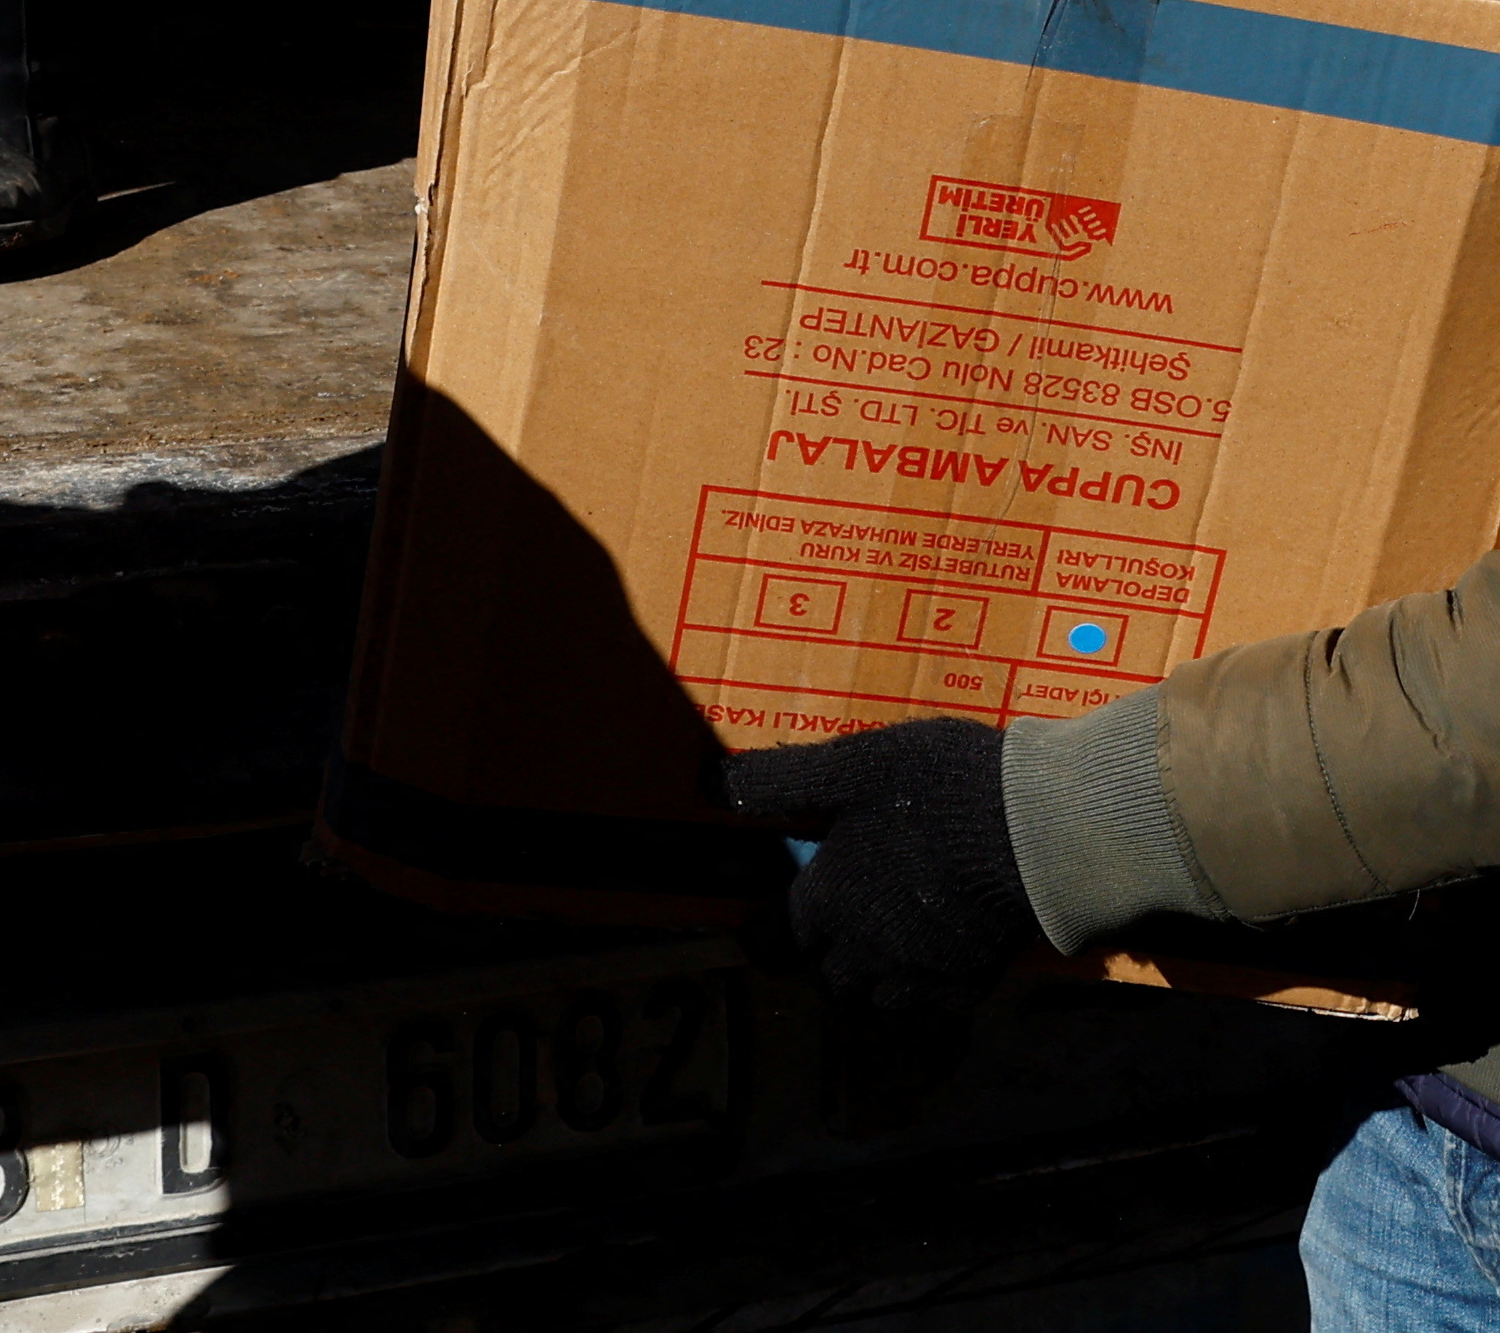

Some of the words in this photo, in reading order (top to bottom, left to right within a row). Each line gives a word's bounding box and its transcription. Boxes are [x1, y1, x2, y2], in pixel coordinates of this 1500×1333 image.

[940, 188, 1045, 219] ÜRETİM
[956, 213, 1036, 243] YERLİ
[843, 248, 1174, 315] www.cuppa.com.tr
[799, 306, 1001, 354] GAZİANTEP
[1006, 332, 1024, 357] /
[743, 334, 786, 363] 23
[812, 343, 933, 382] Cad.No
[1028, 335, 1192, 382] Şehitkamil
[942, 360, 1015, 393] Nolu
[1022, 371, 1122, 407] 83528
[784, 388, 843, 418] ŞTİ.
[854, 399, 920, 427] LTD.
[1129, 387, 1232, 424] 5.OSB
[931, 408, 988, 437] TİC.
[995, 416, 1029, 436] ve
[1040, 421, 1114, 452] SAN.
[766, 429, 1010, 487] AMBALAJ
[1124, 430, 1184, 467] İNŞ.
[1019, 459, 1181, 511] CUPPA
[719, 508, 796, 534] EDİNİZ.
[800, 519, 919, 547] MUHAFAZA
[799, 541, 862, 563] KURU
[865, 548, 894, 568] VE
[921, 532, 1035, 561] YERLERDE
[897, 552, 1032, 583] RUTUBETSİZ
[1056, 548, 1196, 581] KOŞULLARI
[1055, 571, 1191, 604] DEPOLAMA
[788, 592, 811, 617] 3
[933, 607, 956, 632] 2
[943, 672, 983, 692] 500
[1020, 683, 1080, 703] ADET
[159, 1052, 234, 1195] D
[385, 976, 712, 1160] 6082
